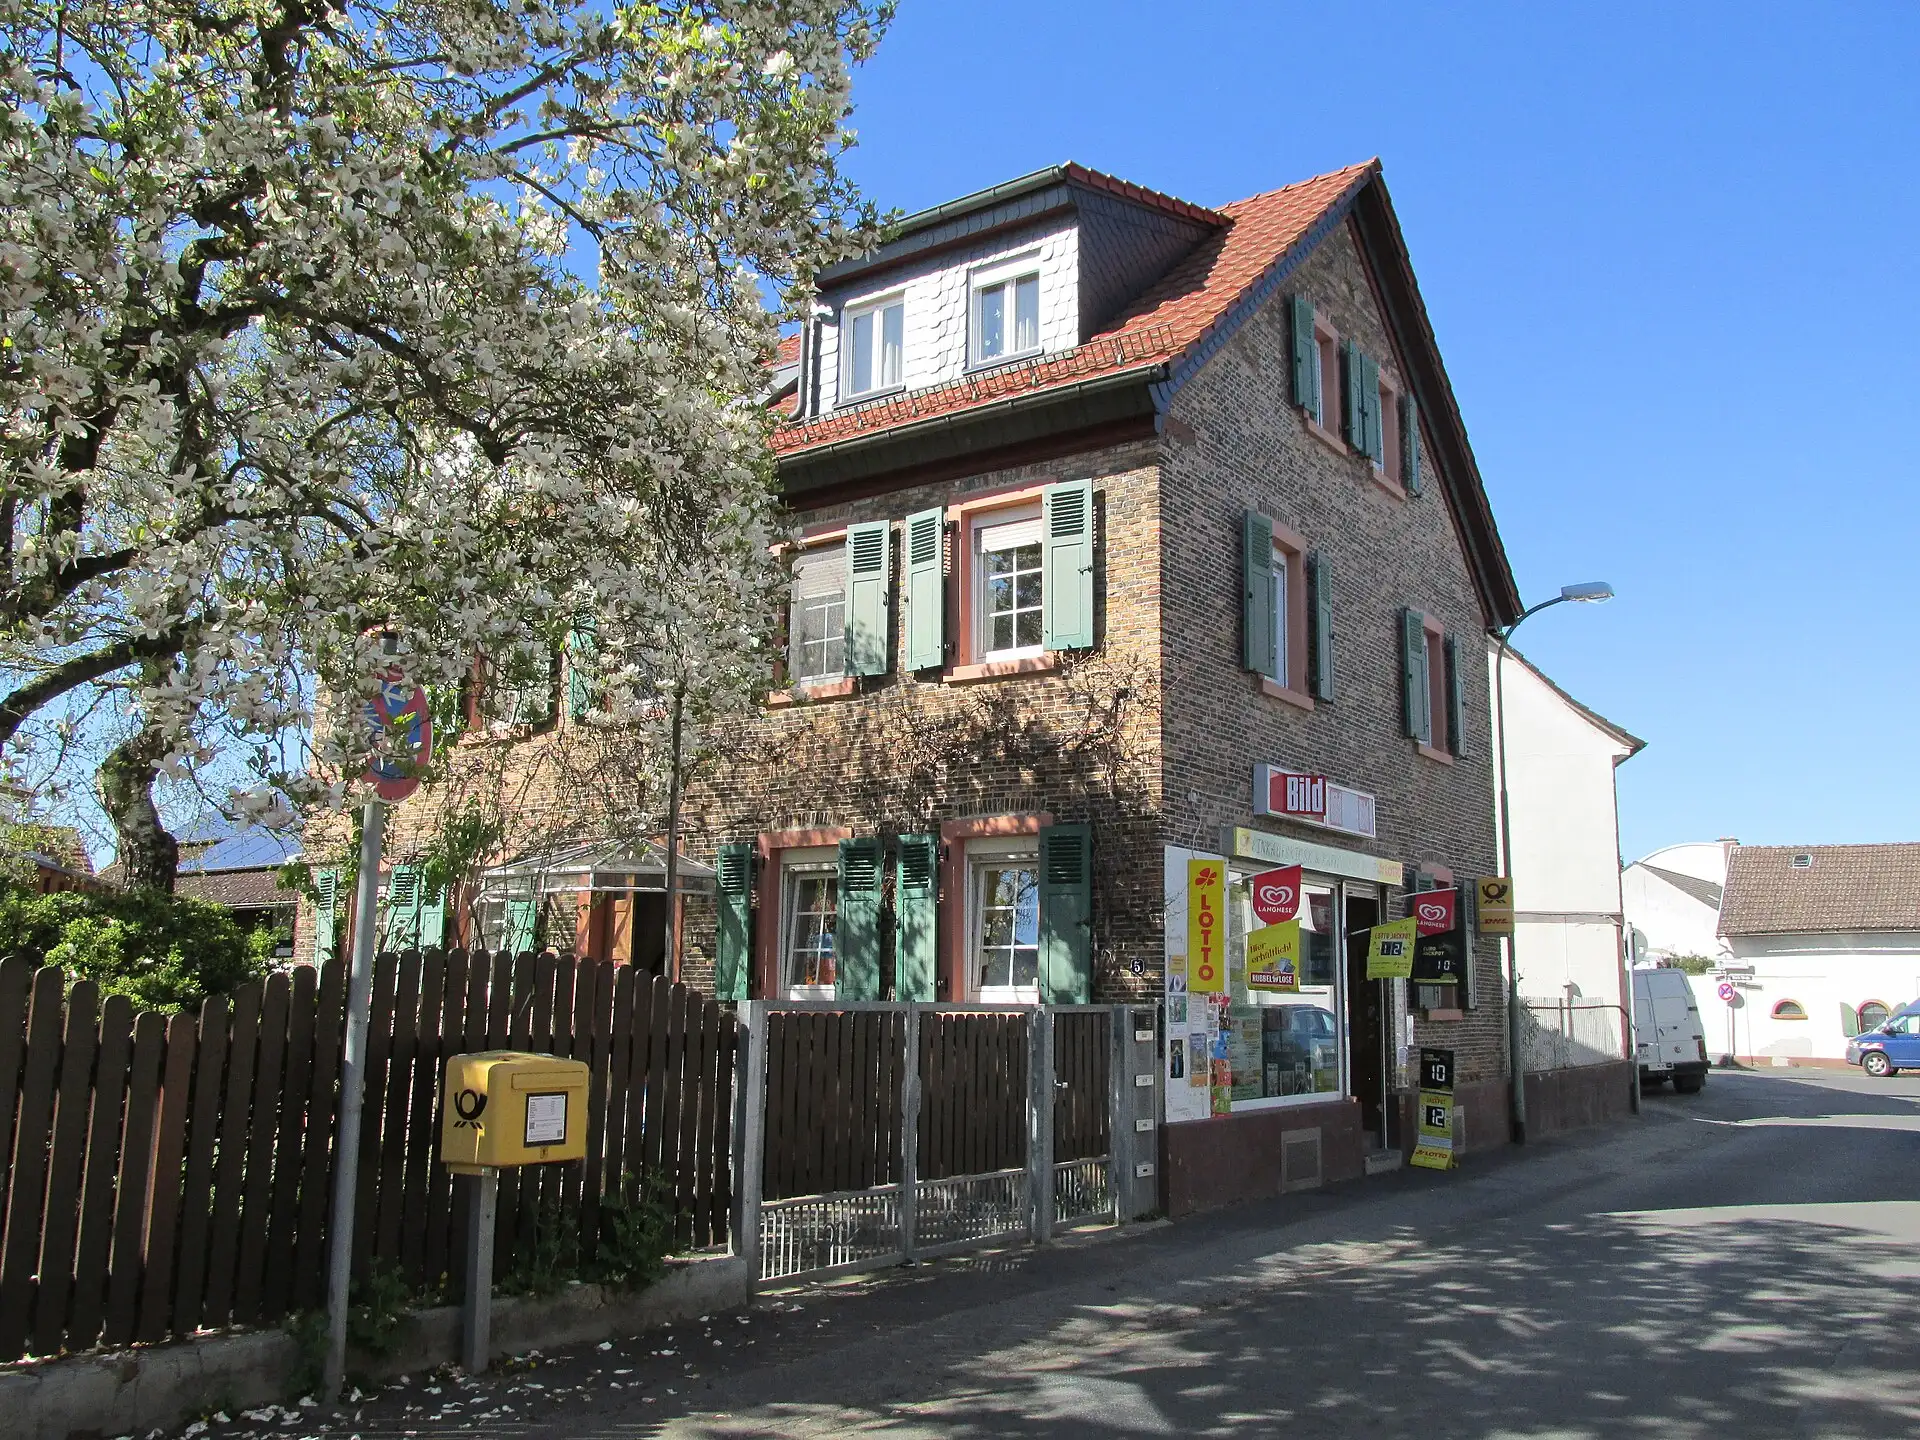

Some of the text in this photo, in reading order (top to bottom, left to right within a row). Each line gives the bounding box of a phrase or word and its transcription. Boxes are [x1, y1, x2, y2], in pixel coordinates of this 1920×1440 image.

[1287, 776, 1323, 812] Bild
[1416, 920, 1446, 928] LANGNESE
[1198, 894, 1215, 981] LOTTO
[1250, 942, 1266, 954] Hier
[1134, 960, 1141, 972] 5
[1431, 1064, 1446, 1082] 10
[1431, 1108, 1445, 1126] 12
[1424, 1151, 1448, 1159] LOTTO
